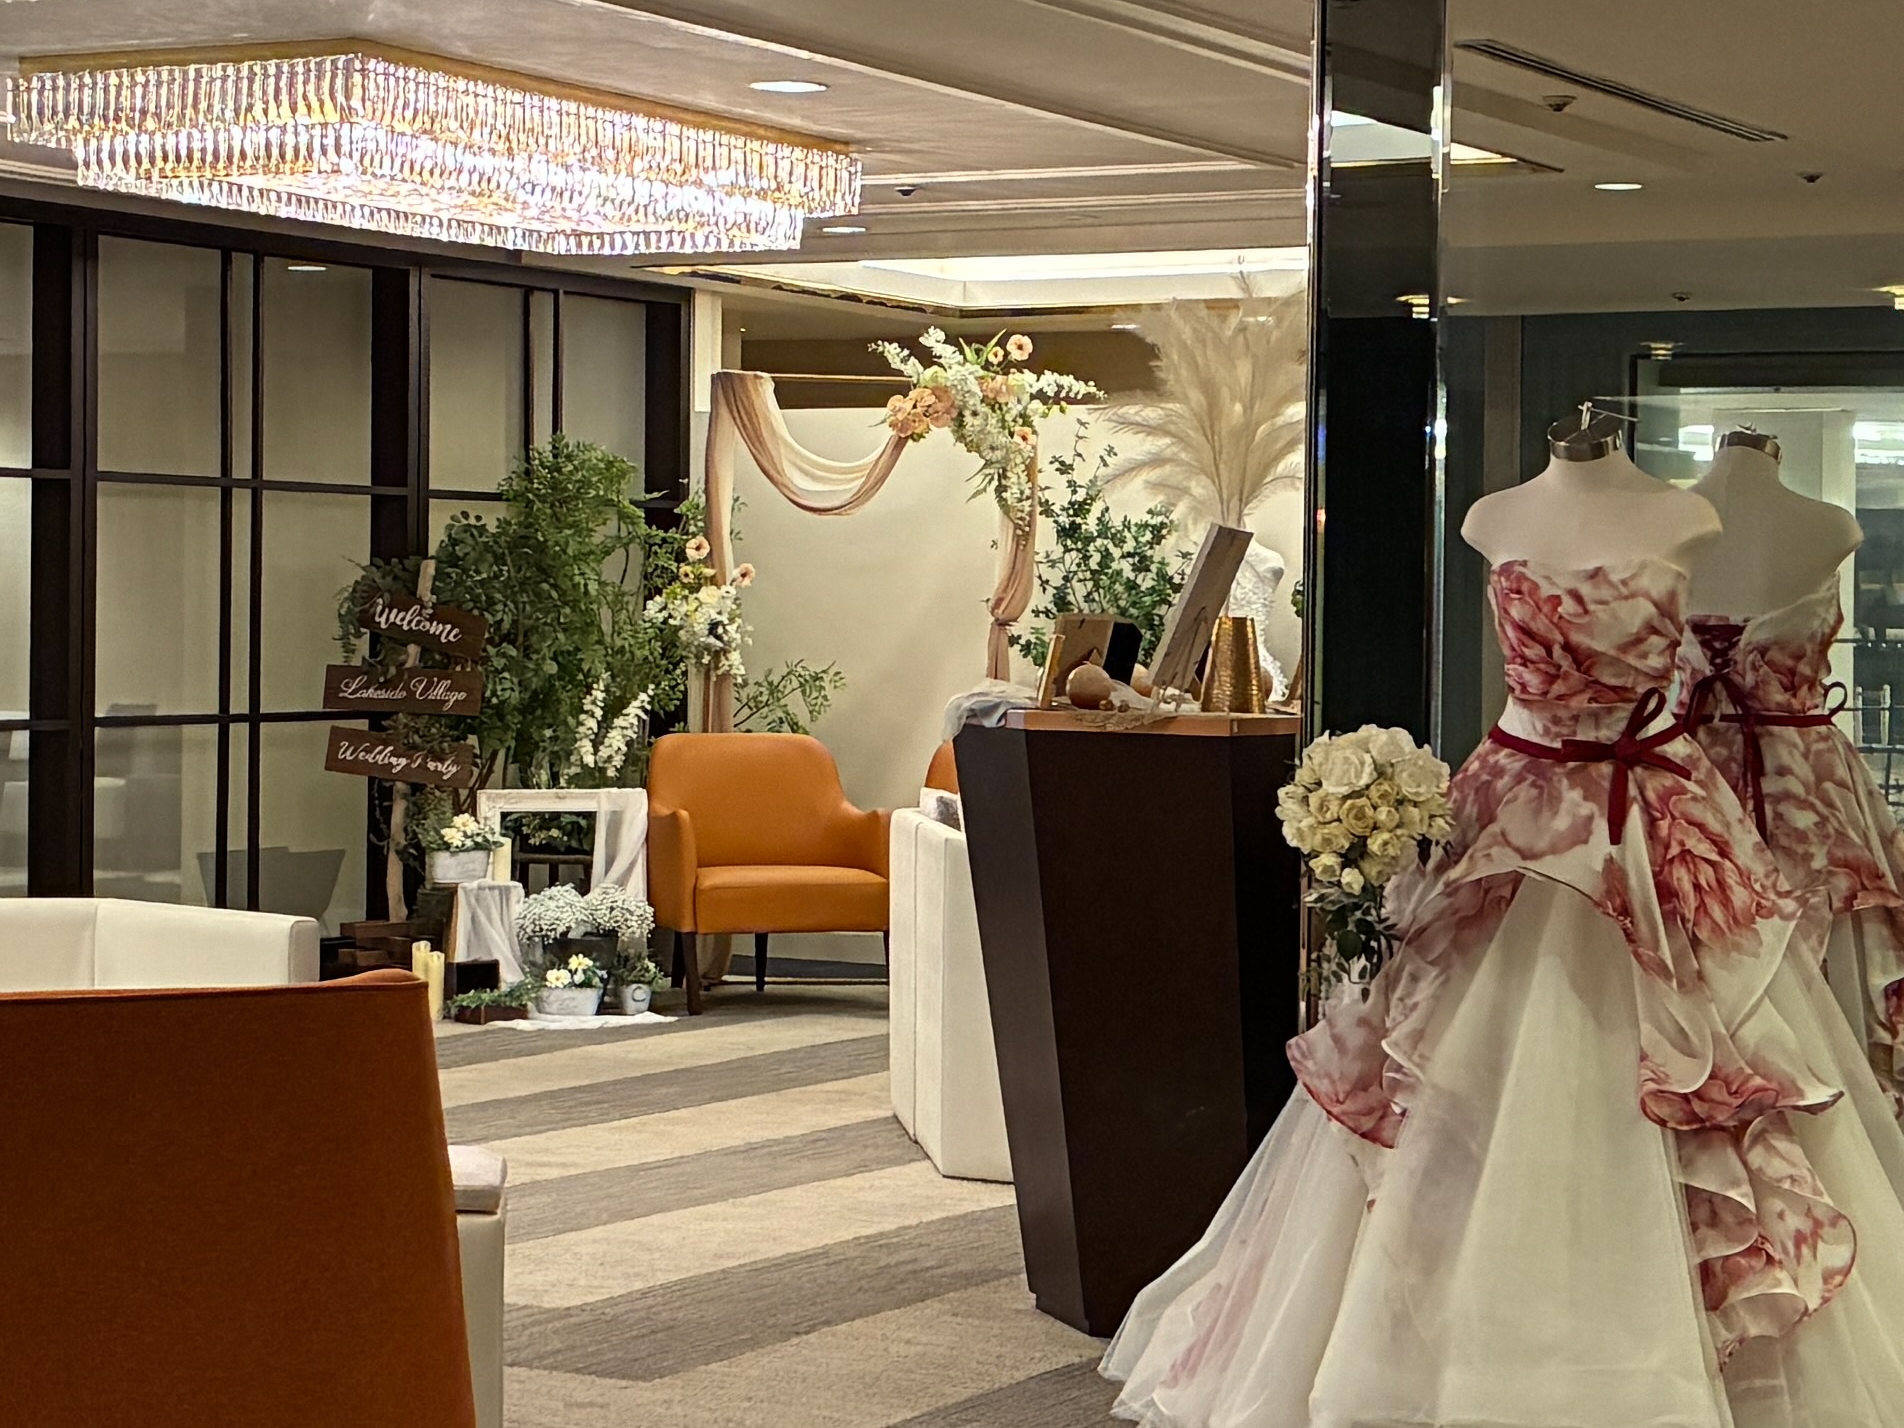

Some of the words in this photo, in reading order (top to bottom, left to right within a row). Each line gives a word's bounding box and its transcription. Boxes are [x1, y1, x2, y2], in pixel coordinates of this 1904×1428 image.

[374, 598, 462, 643] Welcome
[410, 676, 468, 711] Village
[338, 741, 410, 774] Wedding
